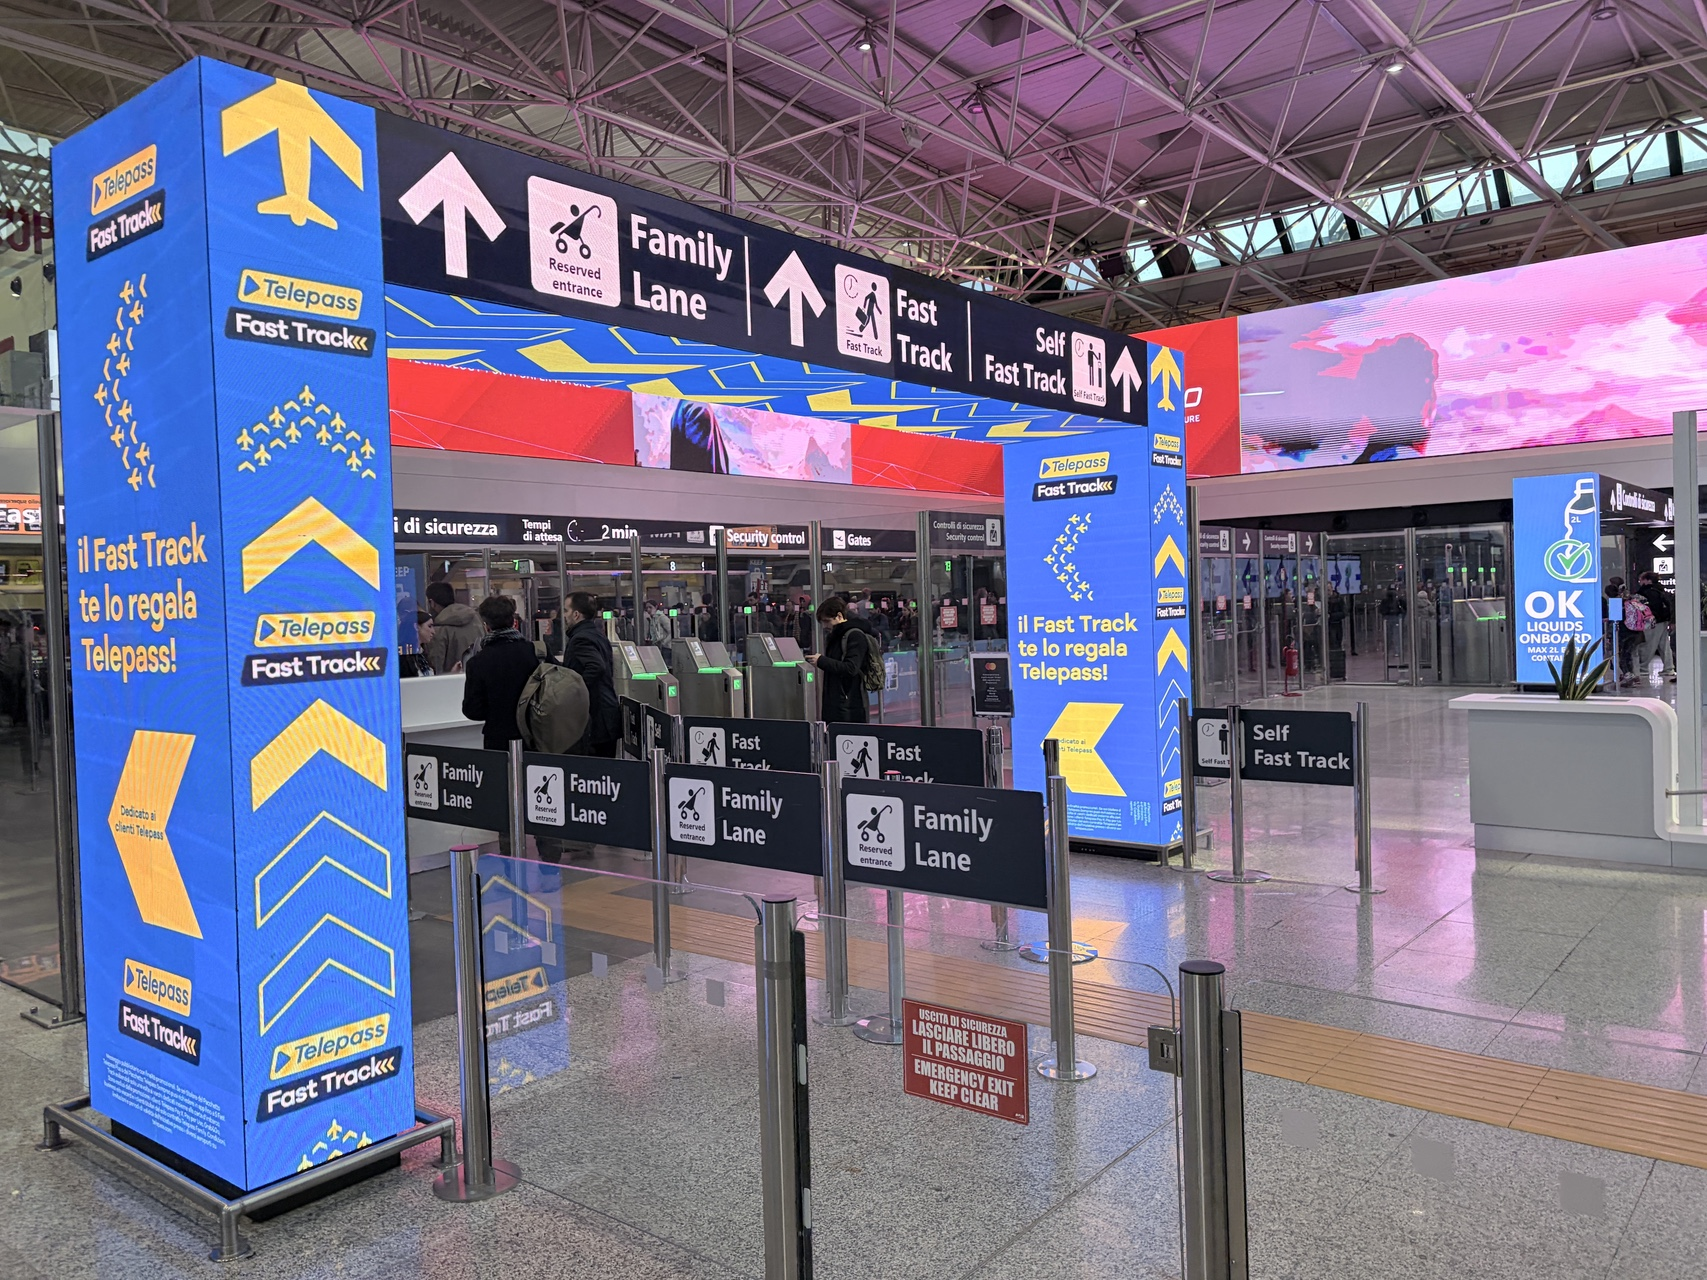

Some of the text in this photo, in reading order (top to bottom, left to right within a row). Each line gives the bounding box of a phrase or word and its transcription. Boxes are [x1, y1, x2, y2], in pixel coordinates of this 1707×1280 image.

[103, 156, 154, 199] Telepass
[90, 202, 154, 252] Fast Track
[631, 213, 733, 281] Family
[549, 257, 601, 281] Reserved
[263, 279, 358, 312] Telepass
[552, 278, 603, 299] entrance
[633, 271, 707, 320] Lane
[897, 288, 938, 326] Fast
[235, 313, 354, 350] Fast Track
[846, 340, 883, 357] Fast Track
[897, 334, 953, 372] Track
[1036, 327, 1066, 358] Self
[985, 354, 1067, 396] Fast Track
[1074, 390, 1105, 402] Self Fast Track
[1159, 437, 1178, 449] Telepass
[1052, 457, 1106, 472] Telepass
[1153, 453, 1164, 464] Fast
[1038, 478, 1104, 497] Fast Track
[404, 517, 420, 534] di
[425, 518, 498, 536] sicurezza
[522, 519, 551, 530] Tempi
[601, 525, 610, 539] 2
[612, 525, 638, 539] min
[933, 521, 985, 531] Controlli di sicurezza
[78, 521, 208, 573] il Fast Track
[523, 532, 563, 542] di attesa
[727, 529, 768, 546] Security
[771, 531, 805, 544] control
[848, 533, 871, 546] Gates
[946, 533, 985, 542] Security control
[80, 578, 197, 632] te lo regala
[1162, 590, 1182, 600] Telepass
[1524, 590, 1585, 619] OK
[1018, 612, 1138, 633] il Fast Track
[1157, 607, 1169, 617] Fast
[279, 618, 370, 640] Telepass
[1527, 621, 1583, 632] LIQUIDS
[1018, 637, 1128, 662] te lo regala
[1519, 633, 1592, 645] ONBOARD
[81, 633, 177, 683] Telepass!
[252, 651, 367, 679] Fast Track
[1019, 661, 1108, 685] Telepass!
[732, 733, 761, 751] Fast
[1253, 724, 1290, 742] Self
[887, 742, 922, 762] Fast
[1254, 749, 1350, 770] Fast Track
[442, 762, 483, 788] Family
[414, 790, 433, 799] Reserved
[570, 773, 621, 802] Family
[415, 799, 433, 808] entrance
[443, 789, 472, 810] Lane
[535, 805, 557, 814] Reserved
[722, 787, 783, 819] Family
[121, 805, 156, 821] Dedicato ai
[536, 814, 557, 824] entrance
[571, 803, 607, 826] Lane
[914, 805, 993, 842] Family
[115, 822, 163, 840] clienti Telepass
[679, 821, 705, 832] Reserved
[680, 832, 706, 842] entrance
[722, 820, 766, 845] Lane
[859, 843, 892, 855] Reserved
[915, 842, 971, 871] Lane
[860, 856, 892, 867] entrance
[136, 968, 188, 1006] Telepass
[123, 1006, 188, 1053] Fast Track
[919, 1009, 1007, 1038] USCITA DI SICUREZZA
[295, 1024, 384, 1064] Telepass
[912, 1020, 1015, 1057] LASCIARE LIBERO
[922, 1039, 1005, 1072] IL PASSAGGIO
[267, 1056, 380, 1113] Fast Track
[914, 1059, 1014, 1098] EMERGENCY EXIT
[930, 1079, 998, 1111] KEEP CLEAR
